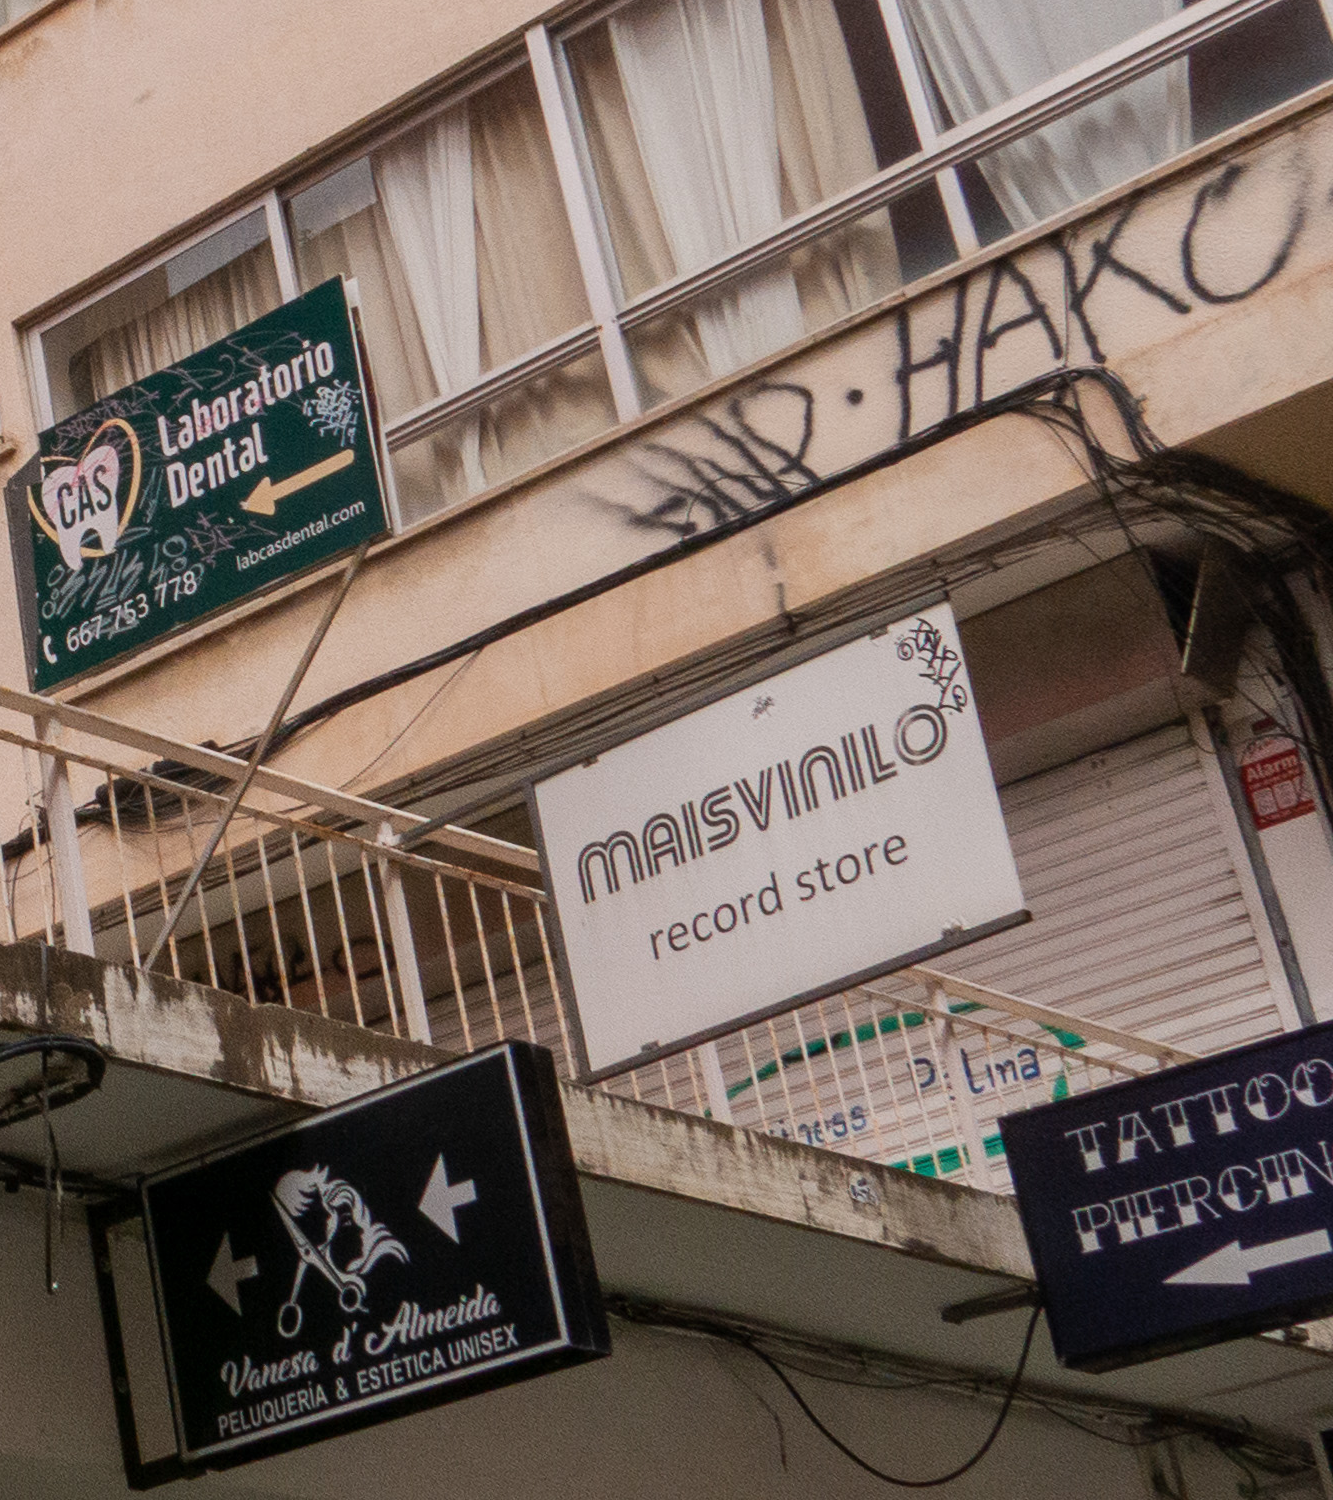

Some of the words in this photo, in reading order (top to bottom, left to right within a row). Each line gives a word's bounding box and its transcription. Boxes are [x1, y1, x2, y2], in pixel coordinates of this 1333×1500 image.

[157, 339, 335, 458] Laboratorio
[56, 463, 113, 530] CAS
[166, 422, 268, 509] Dental
[236, 500, 366, 572] labcasdental.com
[66, 614, 103, 653] 667
[109, 593, 149, 630] 753
[155, 571, 197, 608] 778
[577, 703, 949, 904] MAISVINILO
[648, 872, 784, 961] record
[796, 834, 909, 903] store
[1064, 1058, 1333, 1173] TATTOO
[217, 1379, 329, 1438] PELUQUERÍA
[335, 1376, 350, 1401] &
[447, 1323, 520, 1366] UNISEX
[220, 1350, 319, 1398] Vanesa
[364, 1283, 502, 1356] Almeida
